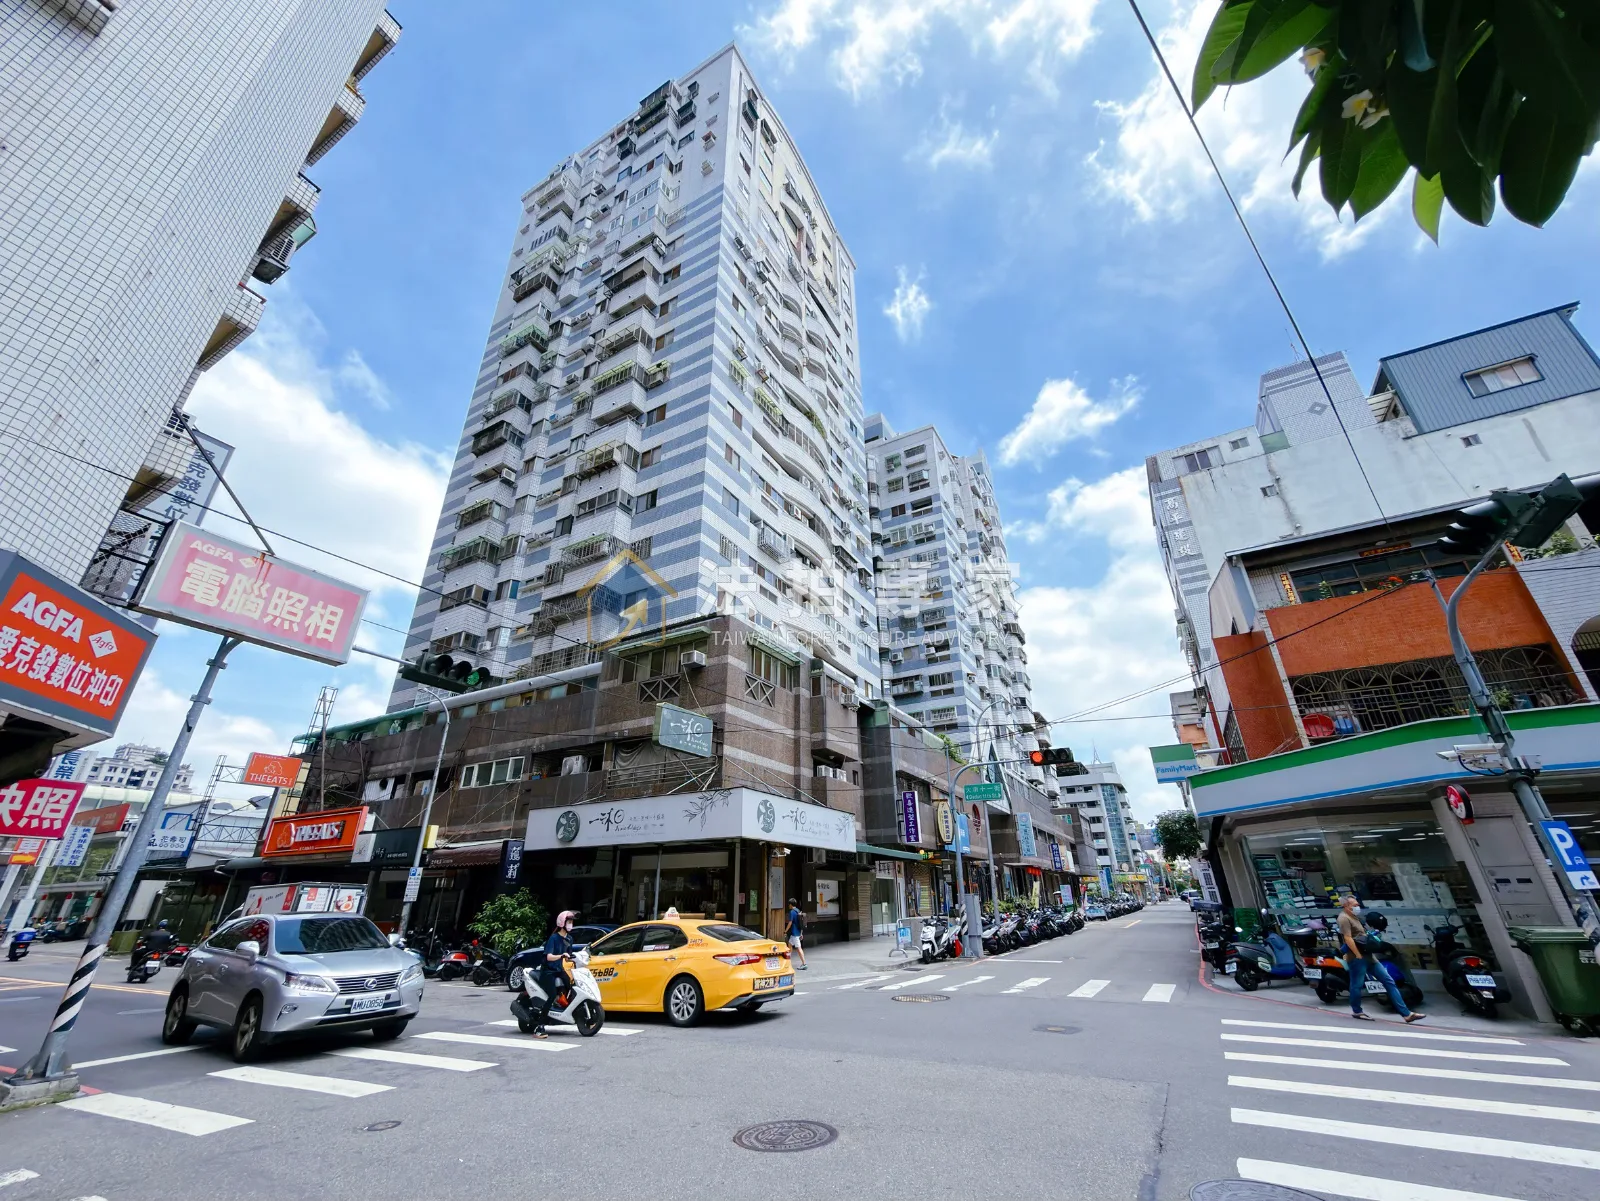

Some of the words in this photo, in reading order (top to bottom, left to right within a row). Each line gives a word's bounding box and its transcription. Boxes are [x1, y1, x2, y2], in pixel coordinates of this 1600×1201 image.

[189, 539, 234, 563] AGFA
[180, 557, 344, 643] 電腦照相
[11, 591, 84, 643] AGFA
[92, 636, 114, 651] Agfa
[1156, 764, 1197, 774] FamilyMart
[1548, 827, 1575, 866] P
